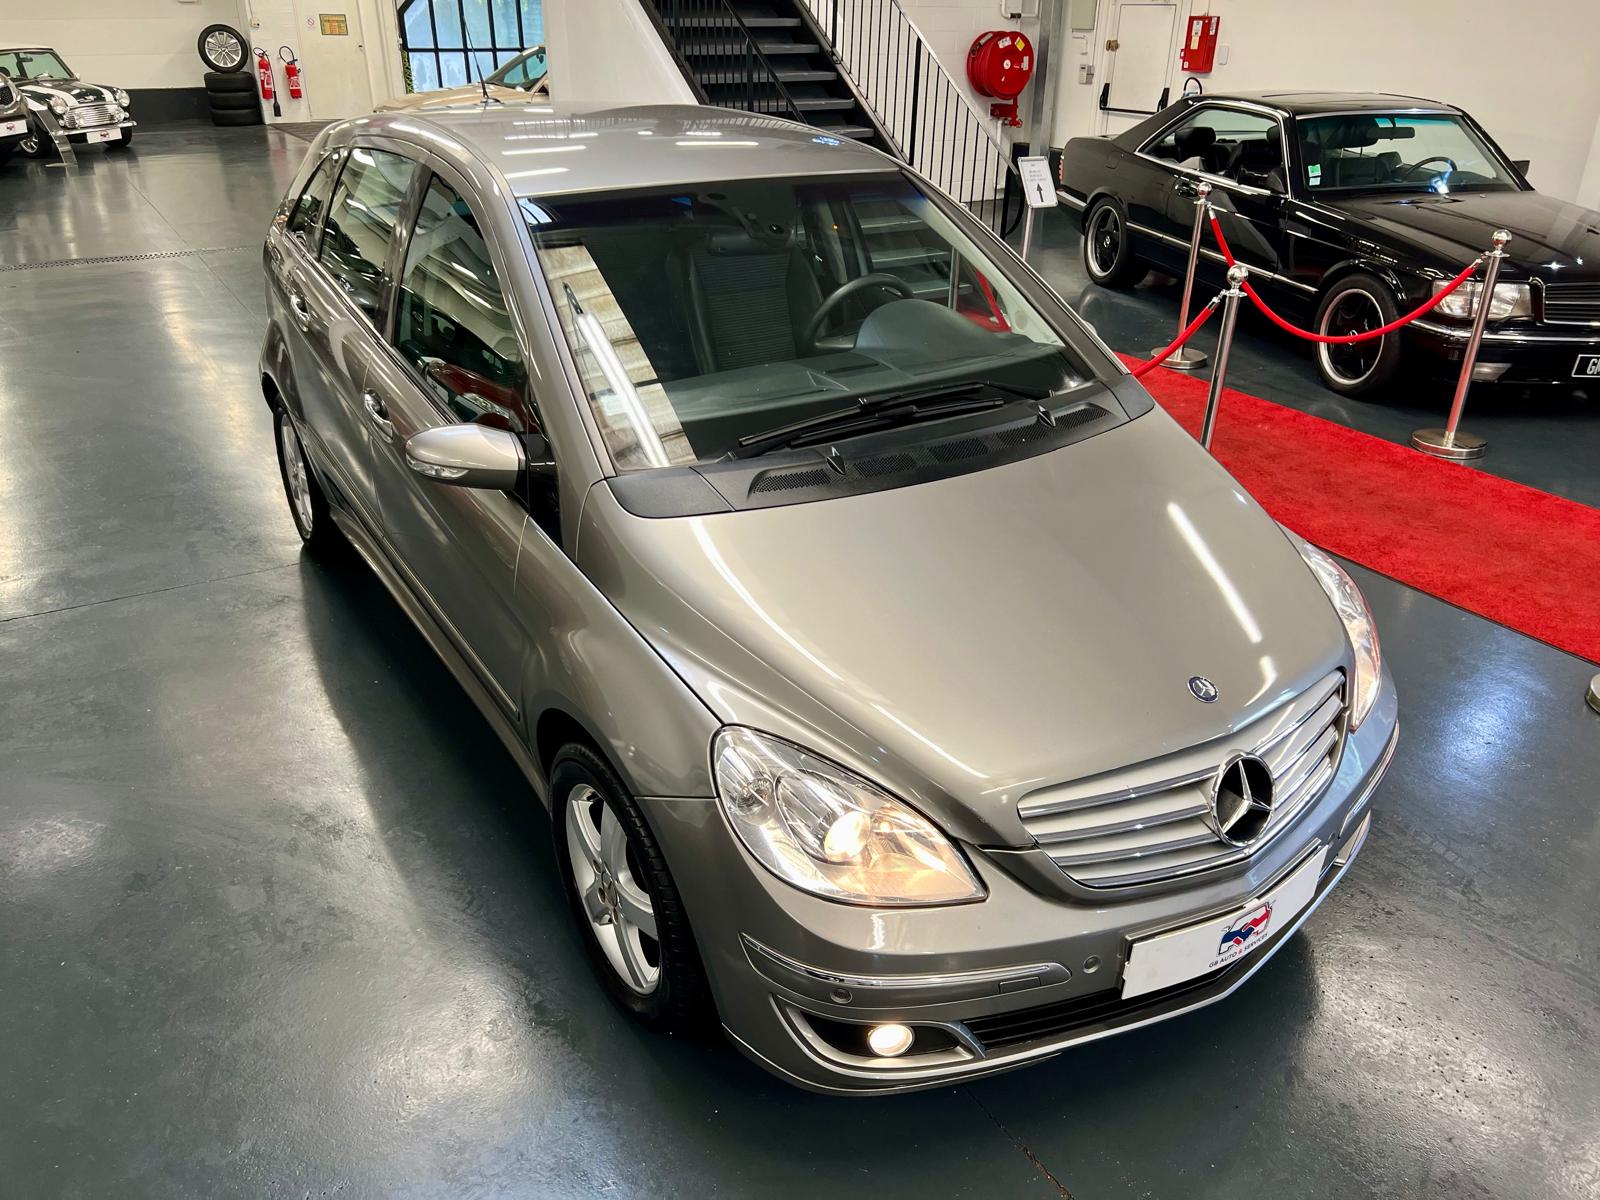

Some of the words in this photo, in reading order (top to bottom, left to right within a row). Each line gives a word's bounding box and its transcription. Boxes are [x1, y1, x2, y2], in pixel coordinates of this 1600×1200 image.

[1209, 960, 1219, 968] GB
[1220, 951, 1238, 963] AUTO
[1244, 933, 1268, 950] SERVICES
